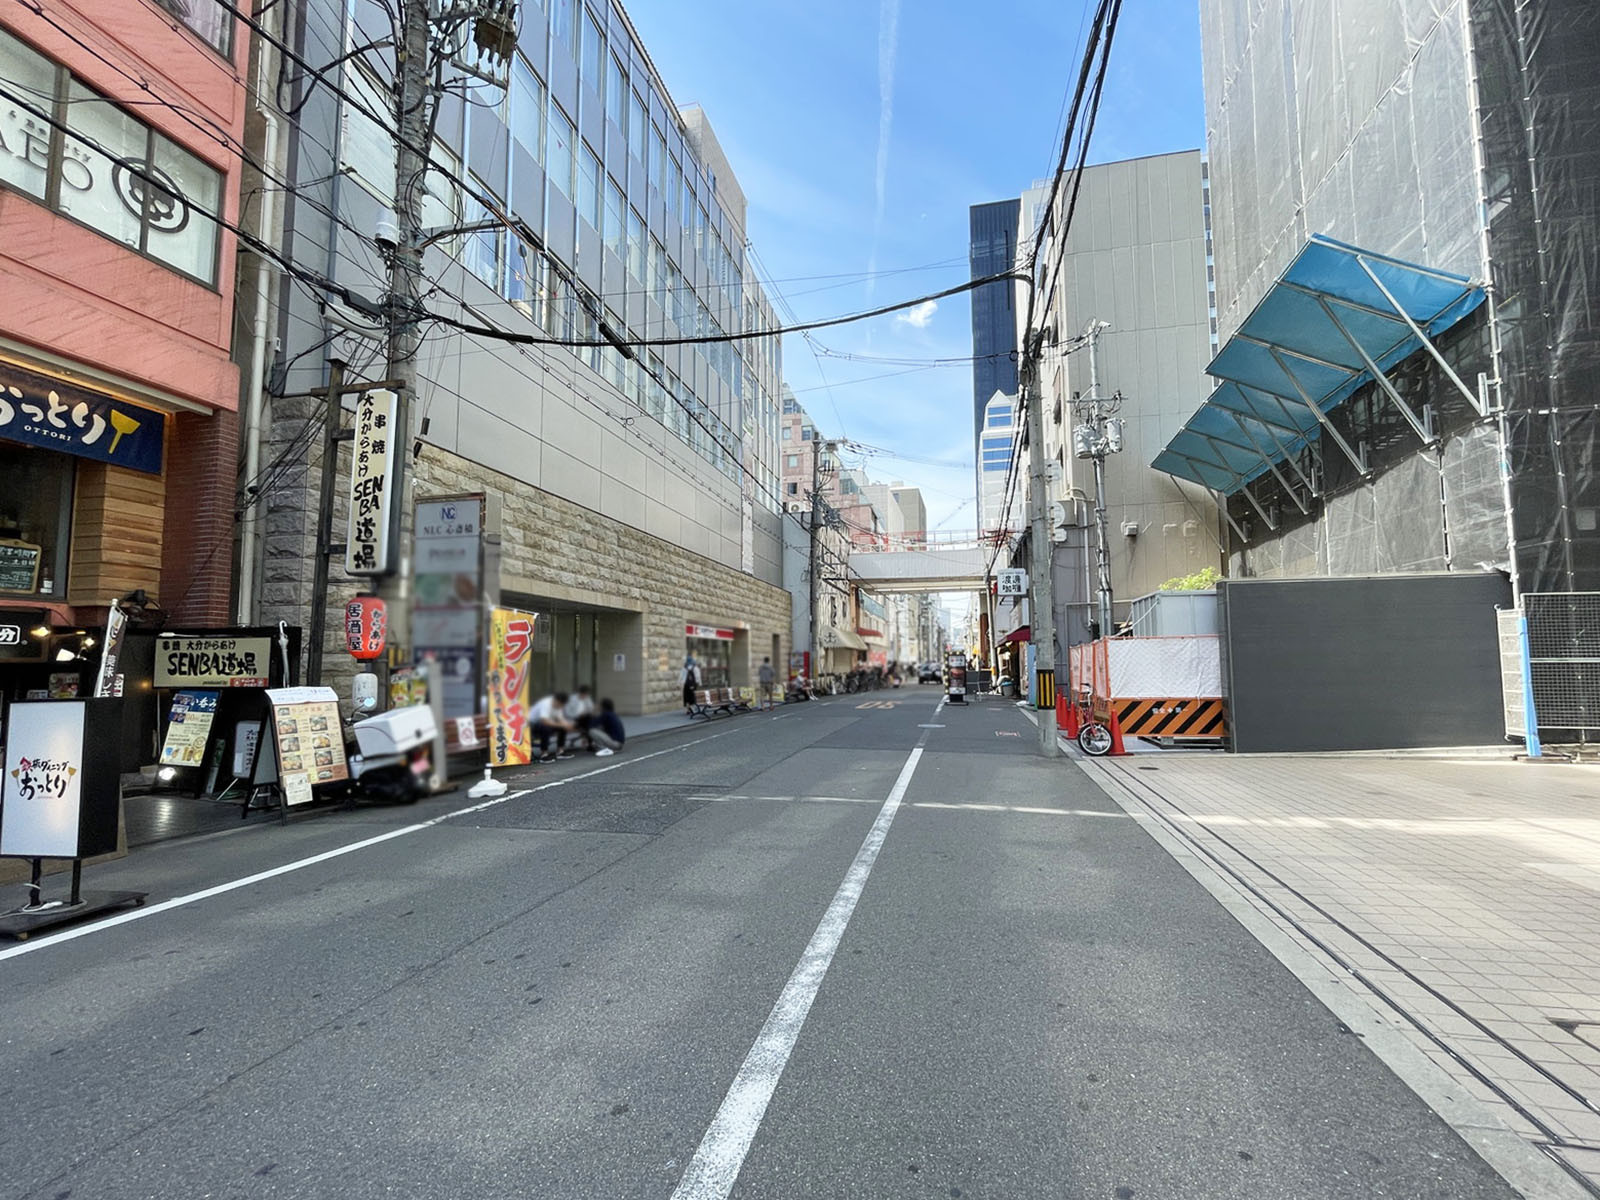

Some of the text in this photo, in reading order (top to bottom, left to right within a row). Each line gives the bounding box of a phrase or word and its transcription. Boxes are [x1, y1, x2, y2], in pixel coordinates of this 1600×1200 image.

[24, 425, 71, 441] OTTORI
[353, 517, 377, 570] 道場
[348, 604, 363, 651] 居酒屋
[504, 620, 531, 744] ランチ
[20, 771, 66, 800] おっとり
